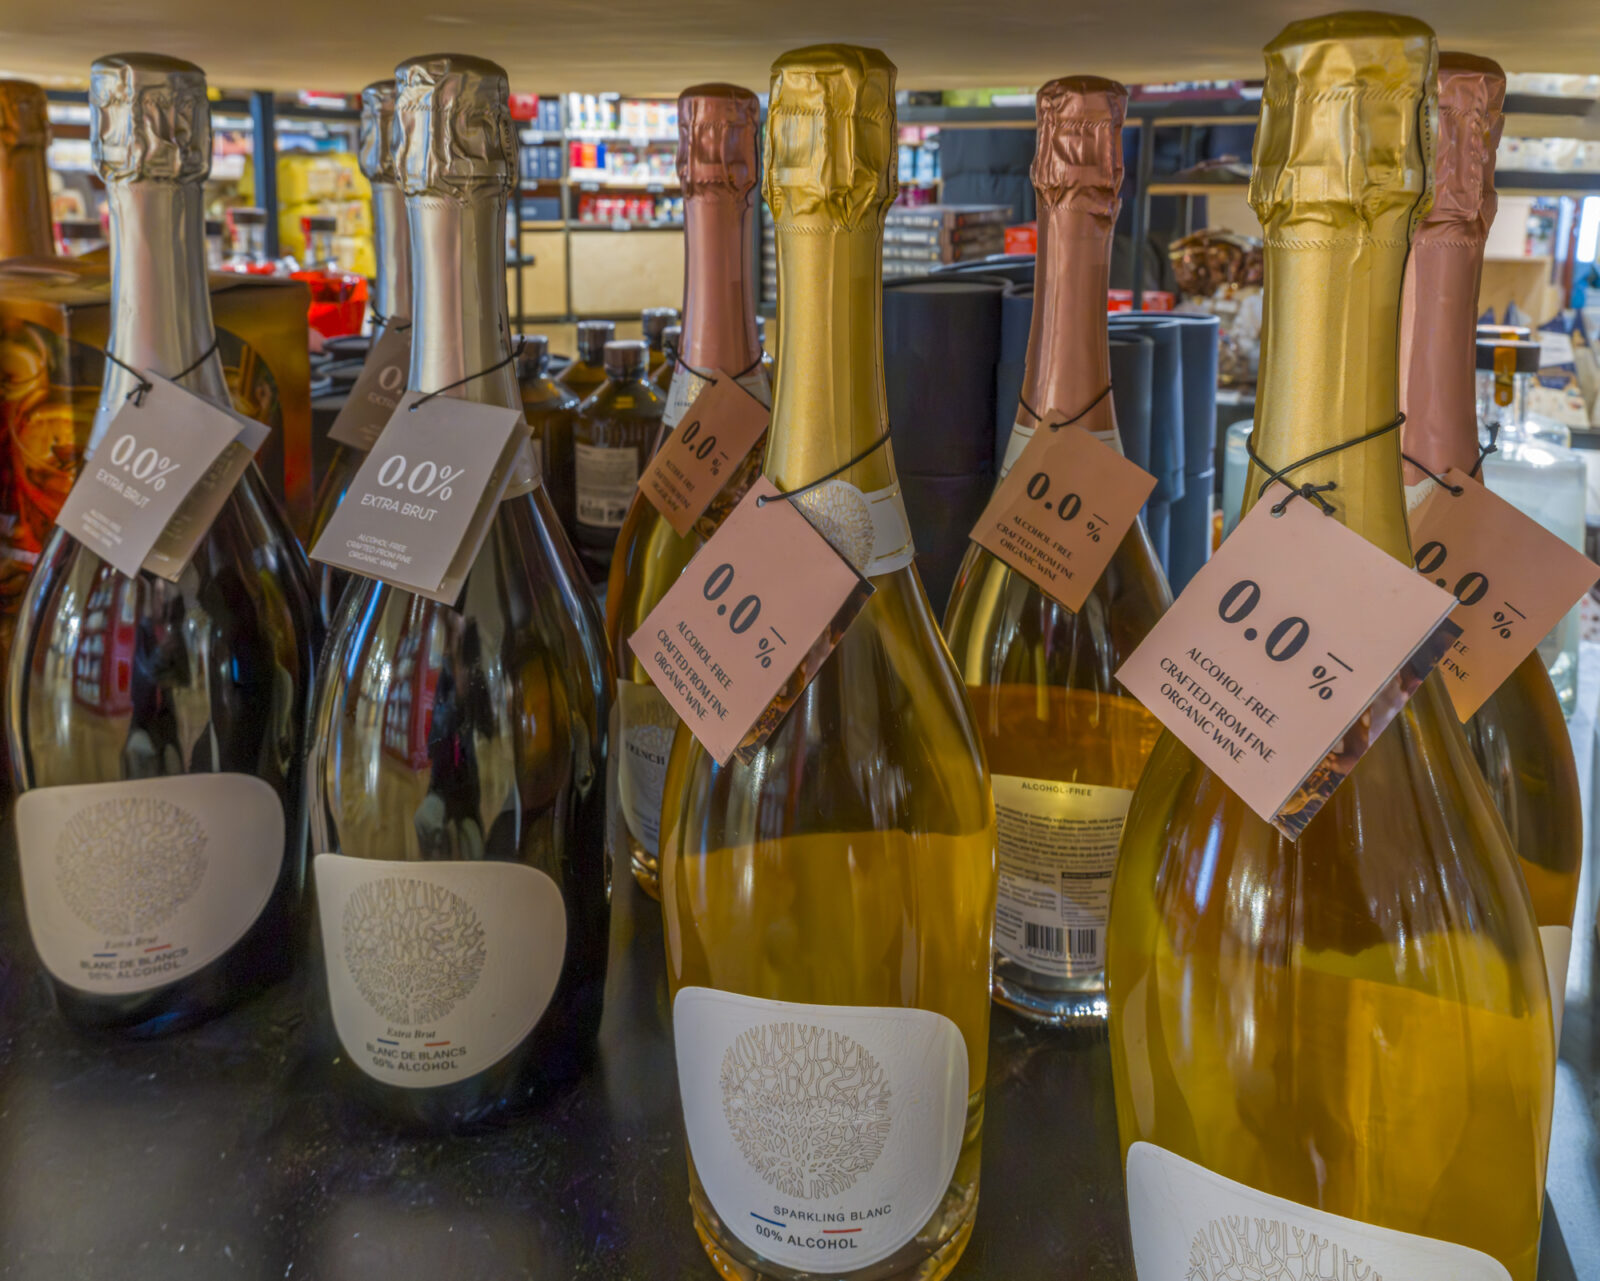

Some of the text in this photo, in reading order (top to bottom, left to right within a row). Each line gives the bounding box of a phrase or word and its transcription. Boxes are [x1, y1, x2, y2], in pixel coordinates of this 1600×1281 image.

[111, 434, 181, 492] 0.0%
[377, 455, 465, 501] 0.0%
[96, 468, 151, 509] EXTRA BRUT
[361, 494, 438, 522] EXTRA BRUT
[1027, 472, 1101, 543] 0.0 %
[996, 522, 1075, 581] CRAFTED FROM FINE
[1000, 537, 1058, 581] ORGANIC WINE
[1414, 541, 1514, 639] 0.0 %
[703, 563, 776, 669] 0.0 %
[676, 620, 734, 691] ALCOHOL-FREE
[1218, 580, 1338, 701] 0.0 %
[653, 651, 709, 721] ORGANIC WINE
[657, 629, 730, 721] CRAFTED FROM FINE
[1185, 646, 1280, 728] ALCOHOL-FREE
[1442, 658, 1470, 682] FINE
[1159, 657, 1277, 763] CRAFTED FROM FINE
[1159, 682, 1248, 764] ORGANIC WINE
[1021, 782, 1093, 797] ALCOHOL-FREE
[116, 959, 183, 979] ALCOHOL
[119, 960, 133, 969] DE
[138, 946, 189, 966] BLANCS
[366, 1042, 467, 1061] BLANC DE BLANCS
[386, 1026, 436, 1039] Extra Brut
[397, 1060, 459, 1073] ALCOHOL
[773, 1204, 893, 1223] SPARKLING BLANC
[787, 1234, 858, 1250] ALCOHOL
